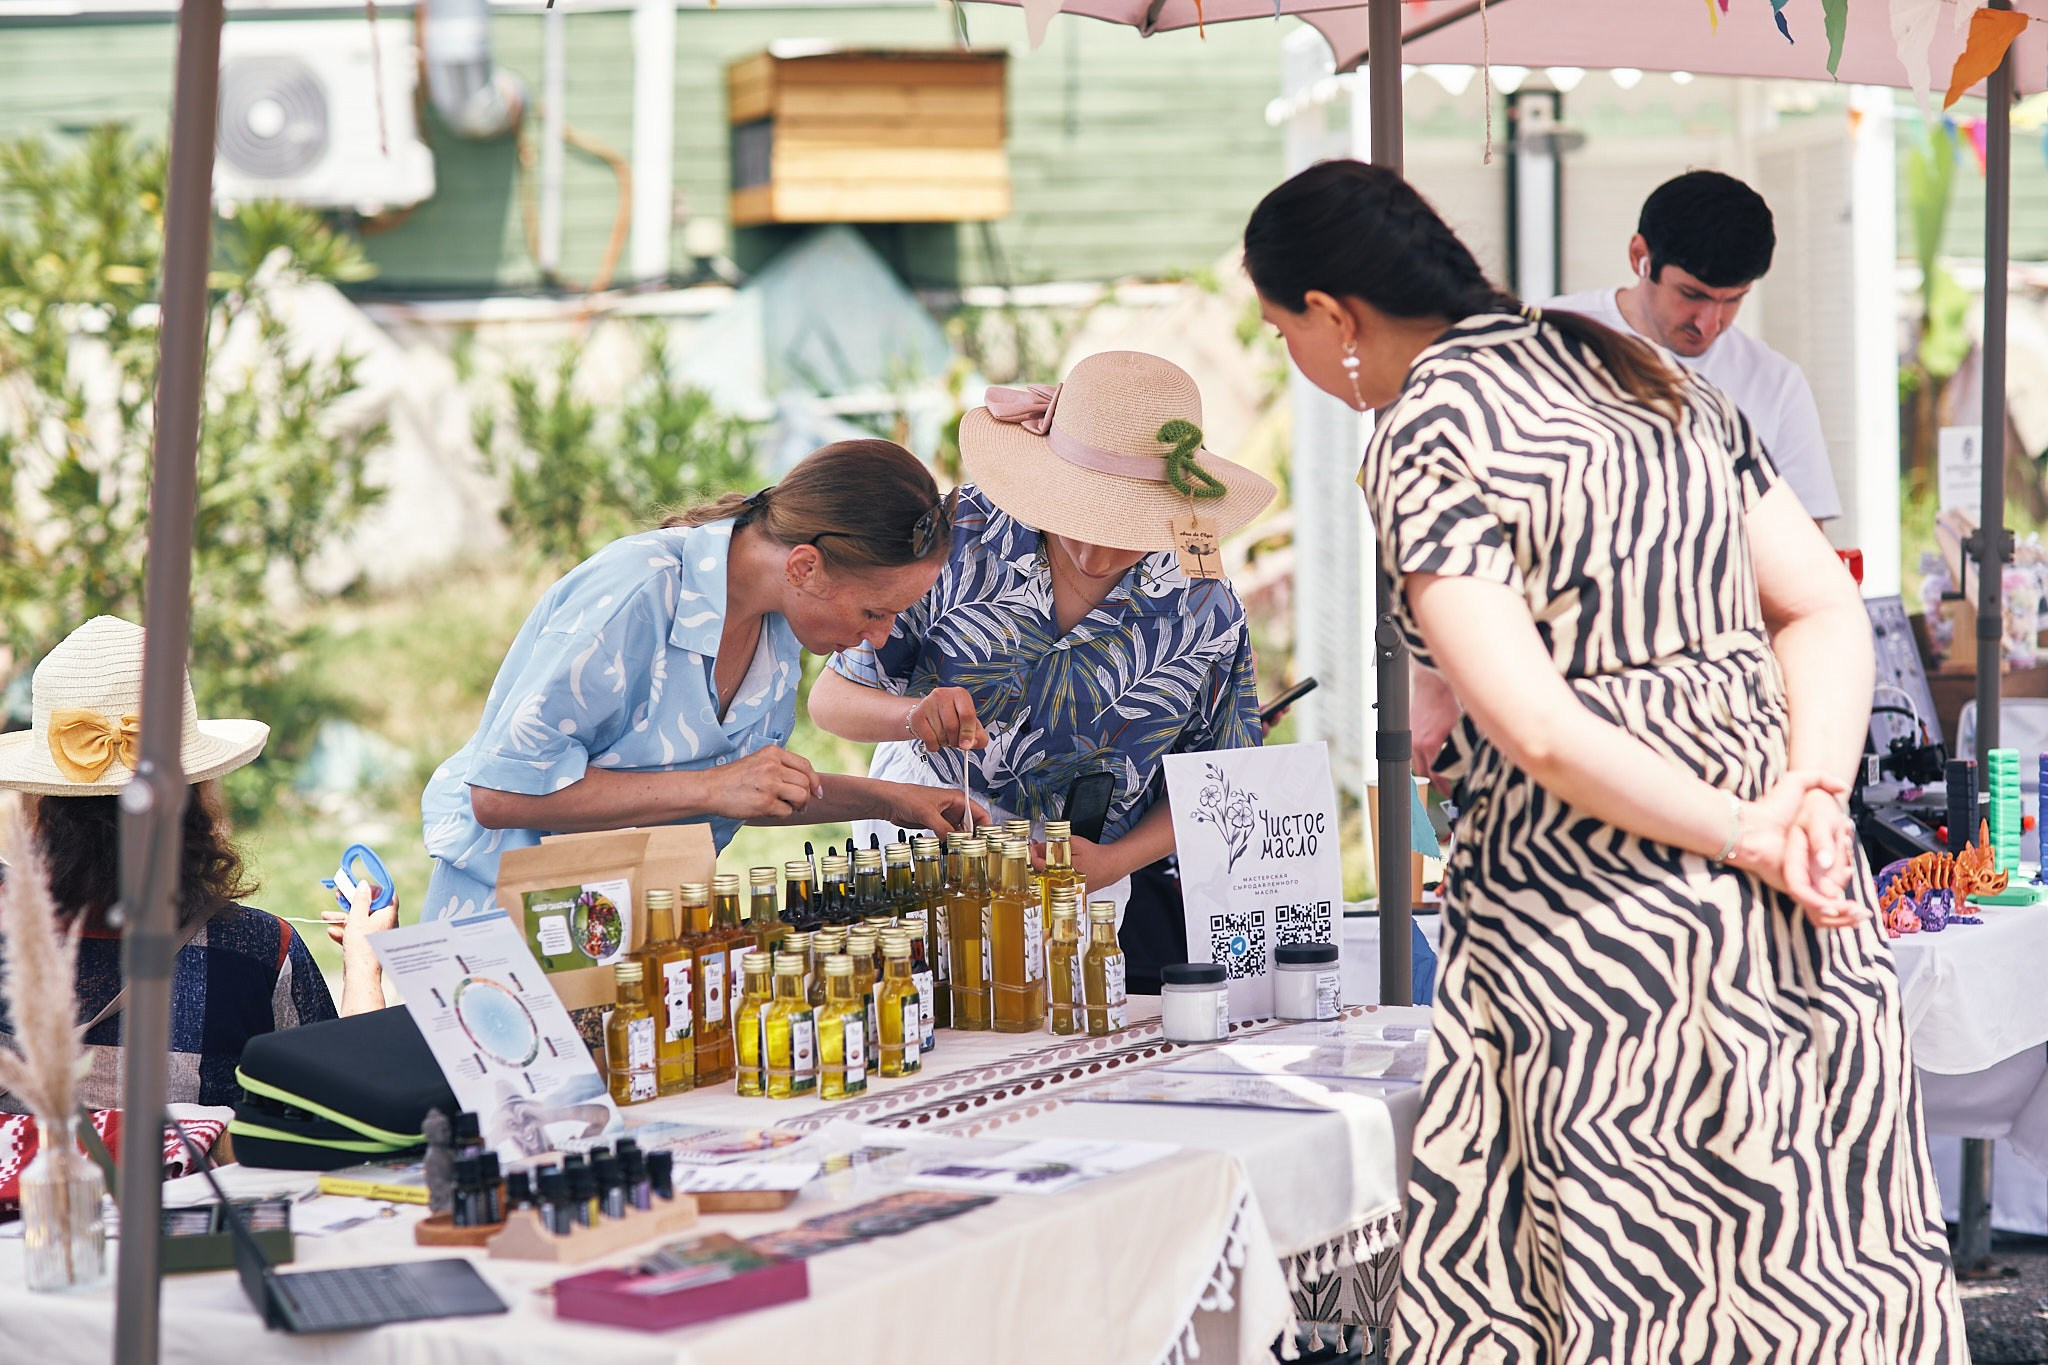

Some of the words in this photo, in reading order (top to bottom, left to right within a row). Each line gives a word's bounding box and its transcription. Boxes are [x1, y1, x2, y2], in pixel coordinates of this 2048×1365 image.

[1259, 809, 1325, 838] Чистое
[1261, 834, 1317, 860] масло
[1233, 880, 1299, 891] СЫРОДАВЛЕННОГО
[1243, 873, 1288, 882] МАСТЕРСКАЯ
